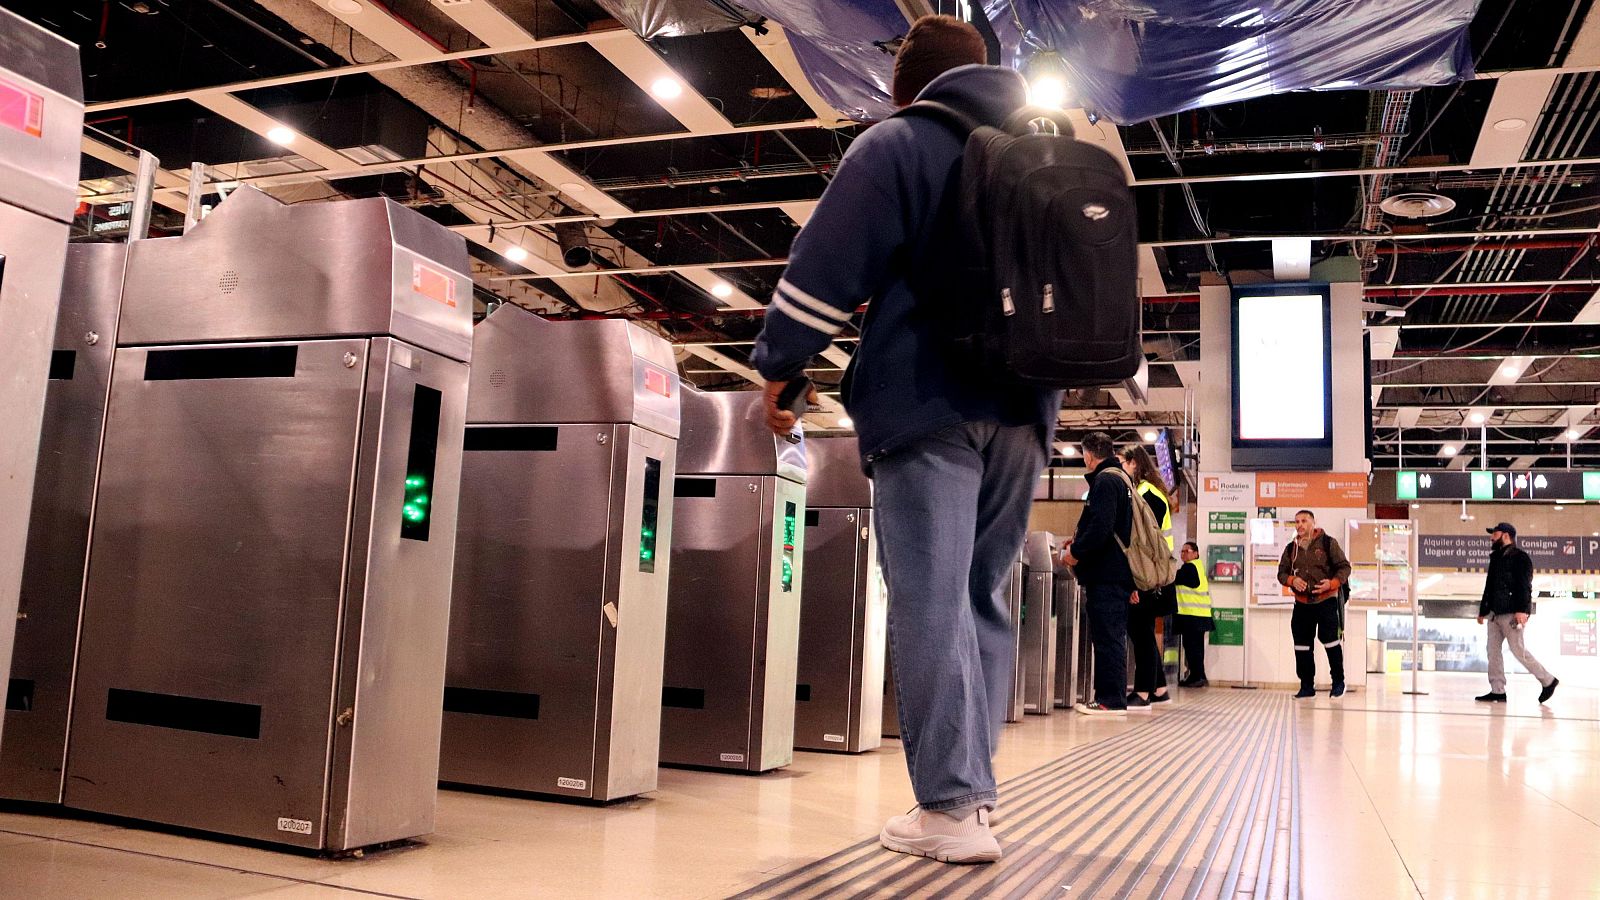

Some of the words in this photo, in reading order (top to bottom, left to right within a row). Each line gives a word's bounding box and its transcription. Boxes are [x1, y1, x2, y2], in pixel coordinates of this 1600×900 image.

[1424, 538, 1454, 547] Alquiler
[1455, 538, 1466, 547] de
[1521, 539, 1558, 549] Consigna
[1589, 540, 1599, 555] P
[1425, 548, 1454, 557] Lloguer
[1456, 548, 1467, 556] de
[279, 820, 309, 831] 1200207
